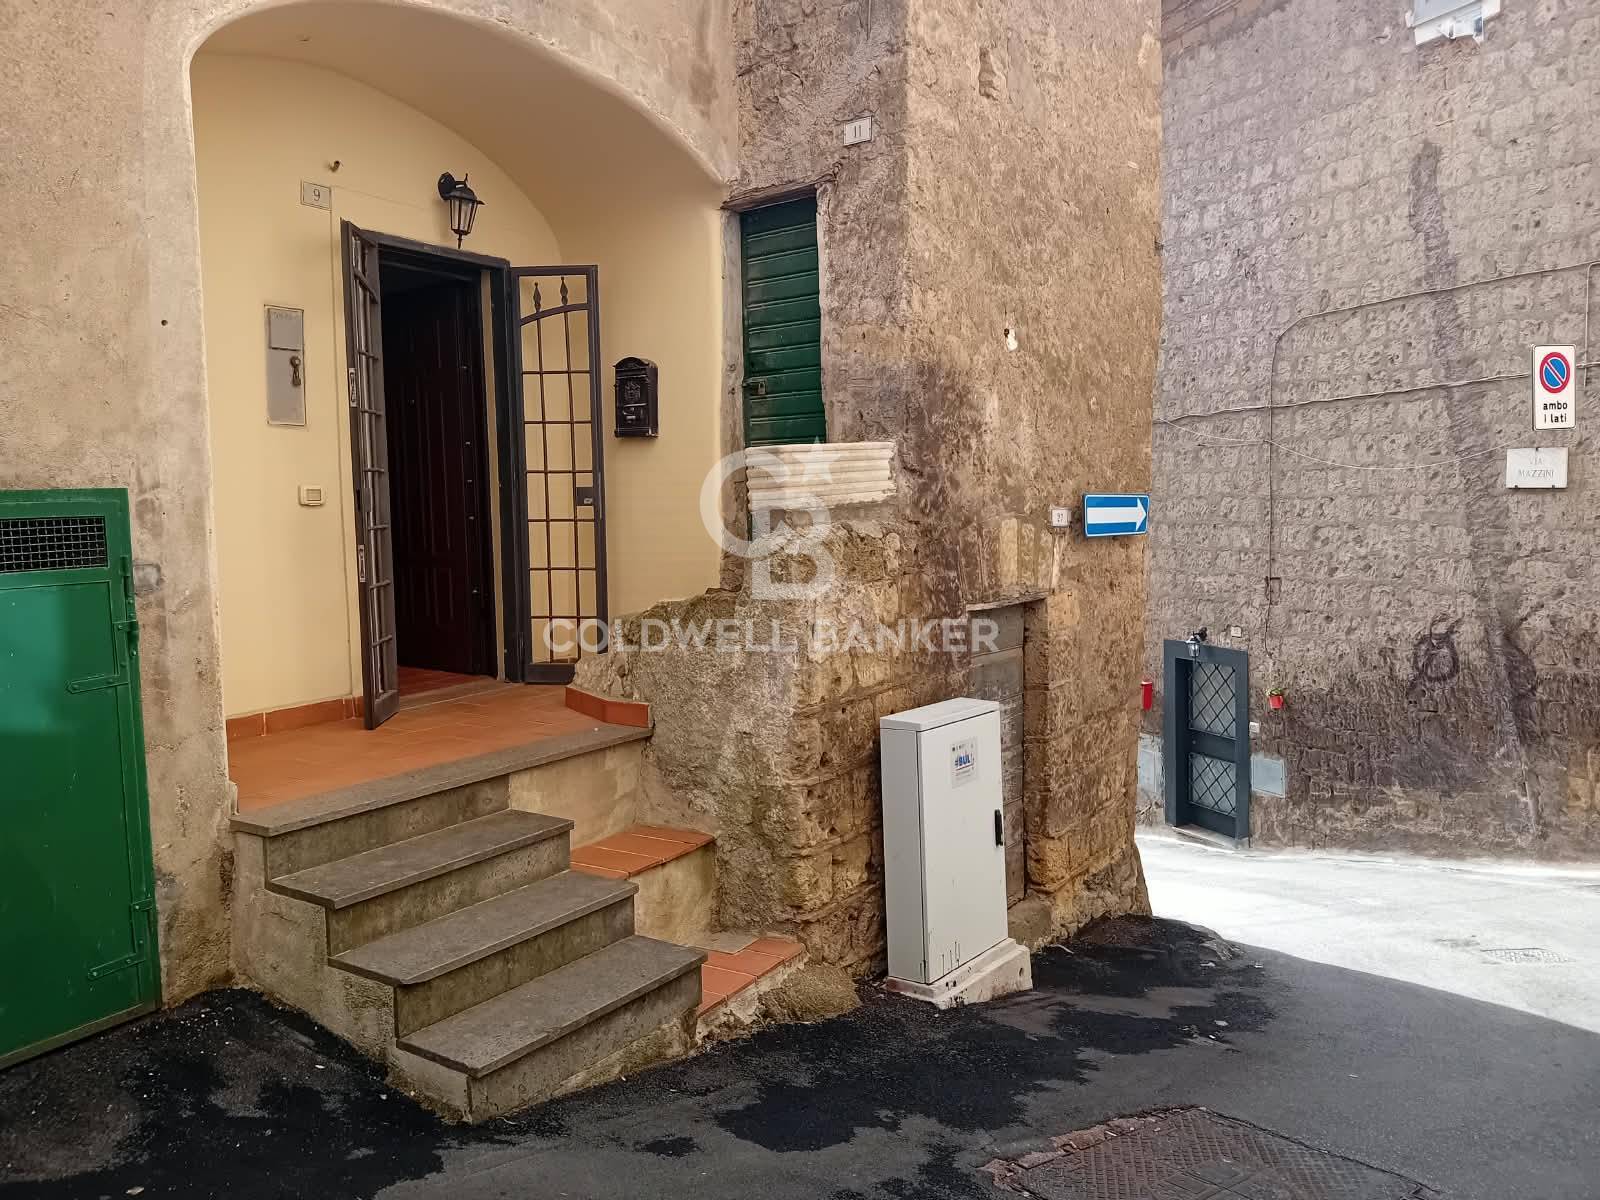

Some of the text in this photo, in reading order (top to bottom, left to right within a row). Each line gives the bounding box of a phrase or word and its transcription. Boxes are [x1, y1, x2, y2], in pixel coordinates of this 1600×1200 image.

[854, 125, 862, 138] 11
[313, 188, 320, 201] 9
[1543, 401, 1568, 411] ambo
[1551, 413, 1567, 423] lati
[1518, 469, 1554, 479] MAZZINI
